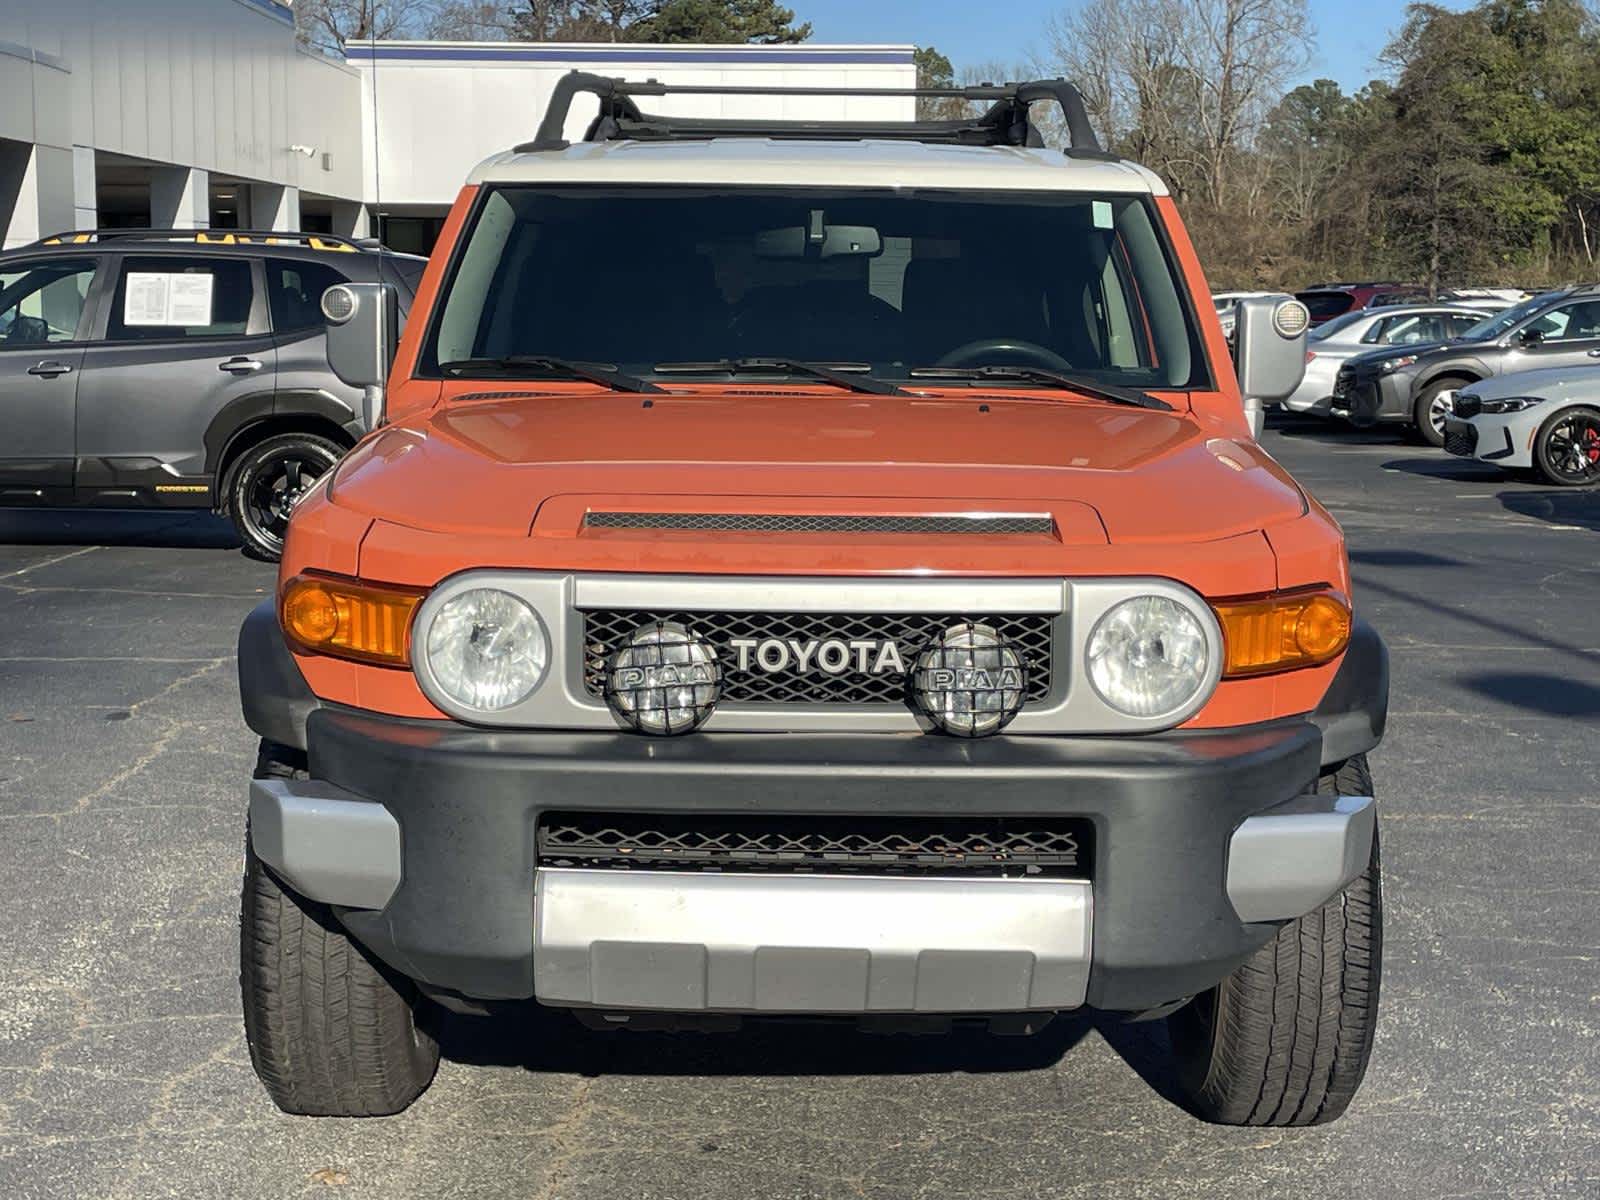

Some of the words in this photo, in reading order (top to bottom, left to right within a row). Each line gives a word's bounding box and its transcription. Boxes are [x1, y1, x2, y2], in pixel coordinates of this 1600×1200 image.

[731, 640, 904, 673] TOYOTA
[618, 662, 714, 690] PIAA
[928, 667, 1023, 690] PIAA
